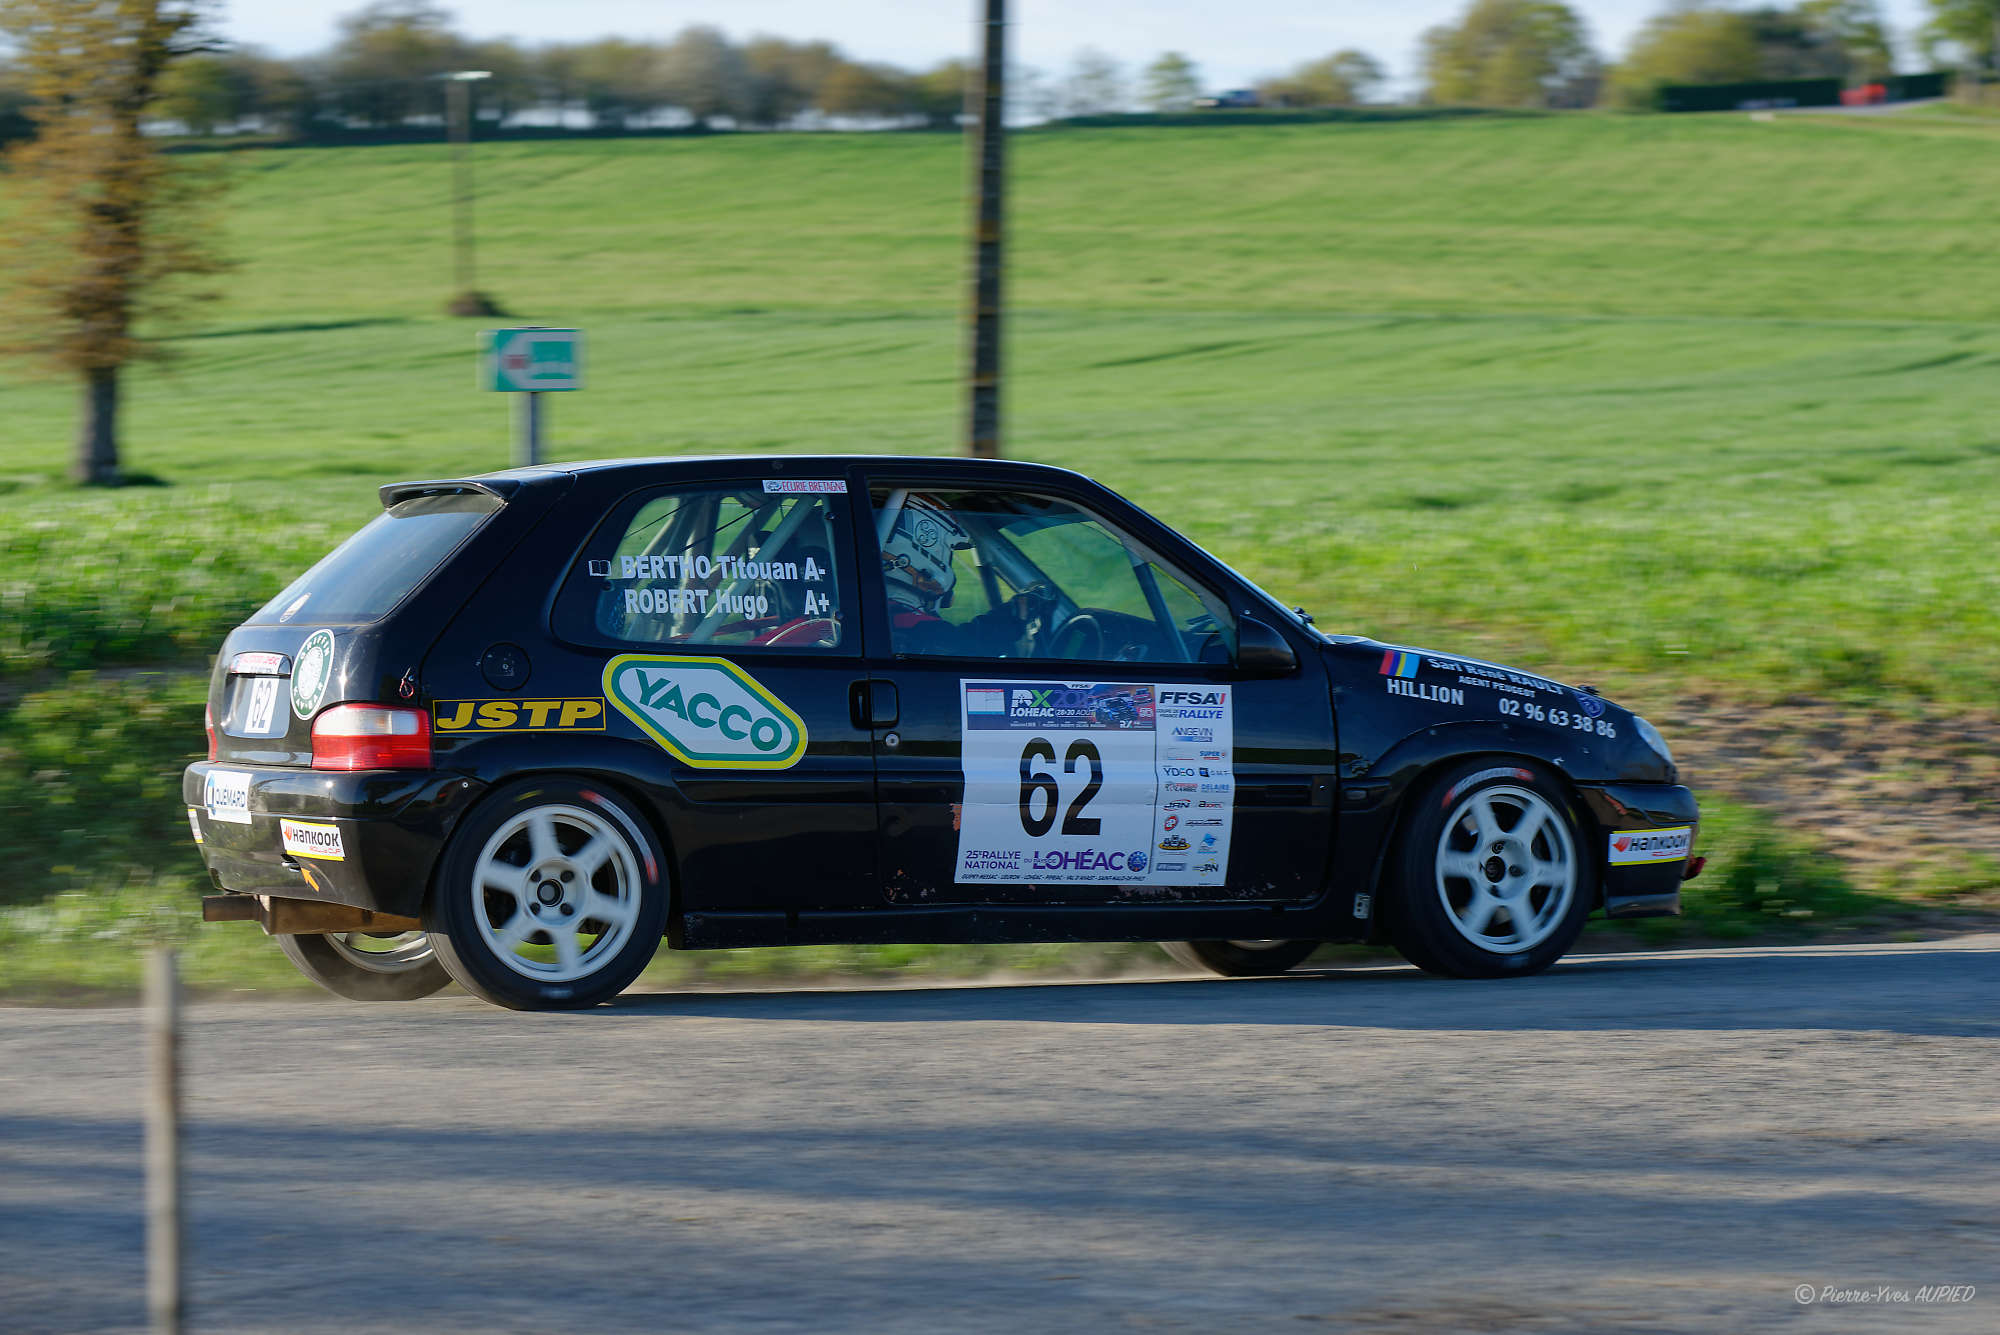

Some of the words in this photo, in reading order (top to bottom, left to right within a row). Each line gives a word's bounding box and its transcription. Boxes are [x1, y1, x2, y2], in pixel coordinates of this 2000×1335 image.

[808, 481, 846, 492] BRETAGNE
[620, 555, 711, 580] BERTHO
[716, 555, 798, 581] Titouan
[804, 557, 826, 581] A-
[624, 588, 709, 615] ROBERT
[716, 589, 769, 620] Hugo
[804, 589, 830, 616] A+
[1160, 691, 1218, 705] FFSA
[1387, 678, 1465, 706] HILLION
[1458, 675, 1491, 688] AGENT
[1491, 681, 1536, 698] PEUGEOT
[436, 700, 602, 729] JSTP
[635, 668, 783, 752] YACCO
[1179, 709, 1224, 719] RALLYE
[1498, 697, 1521, 717] 02
[1523, 702, 1546, 722] 96
[1548, 708, 1570, 727] 63
[1572, 713, 1594, 733] 38
[1595, 719, 1617, 739] 86
[1019, 736, 1104, 838] 62
[965, 861, 1020, 870] NATIONAL
[982, 850, 1022, 860] RALLYE
[1032, 848, 1126, 871] LOHÉAC
